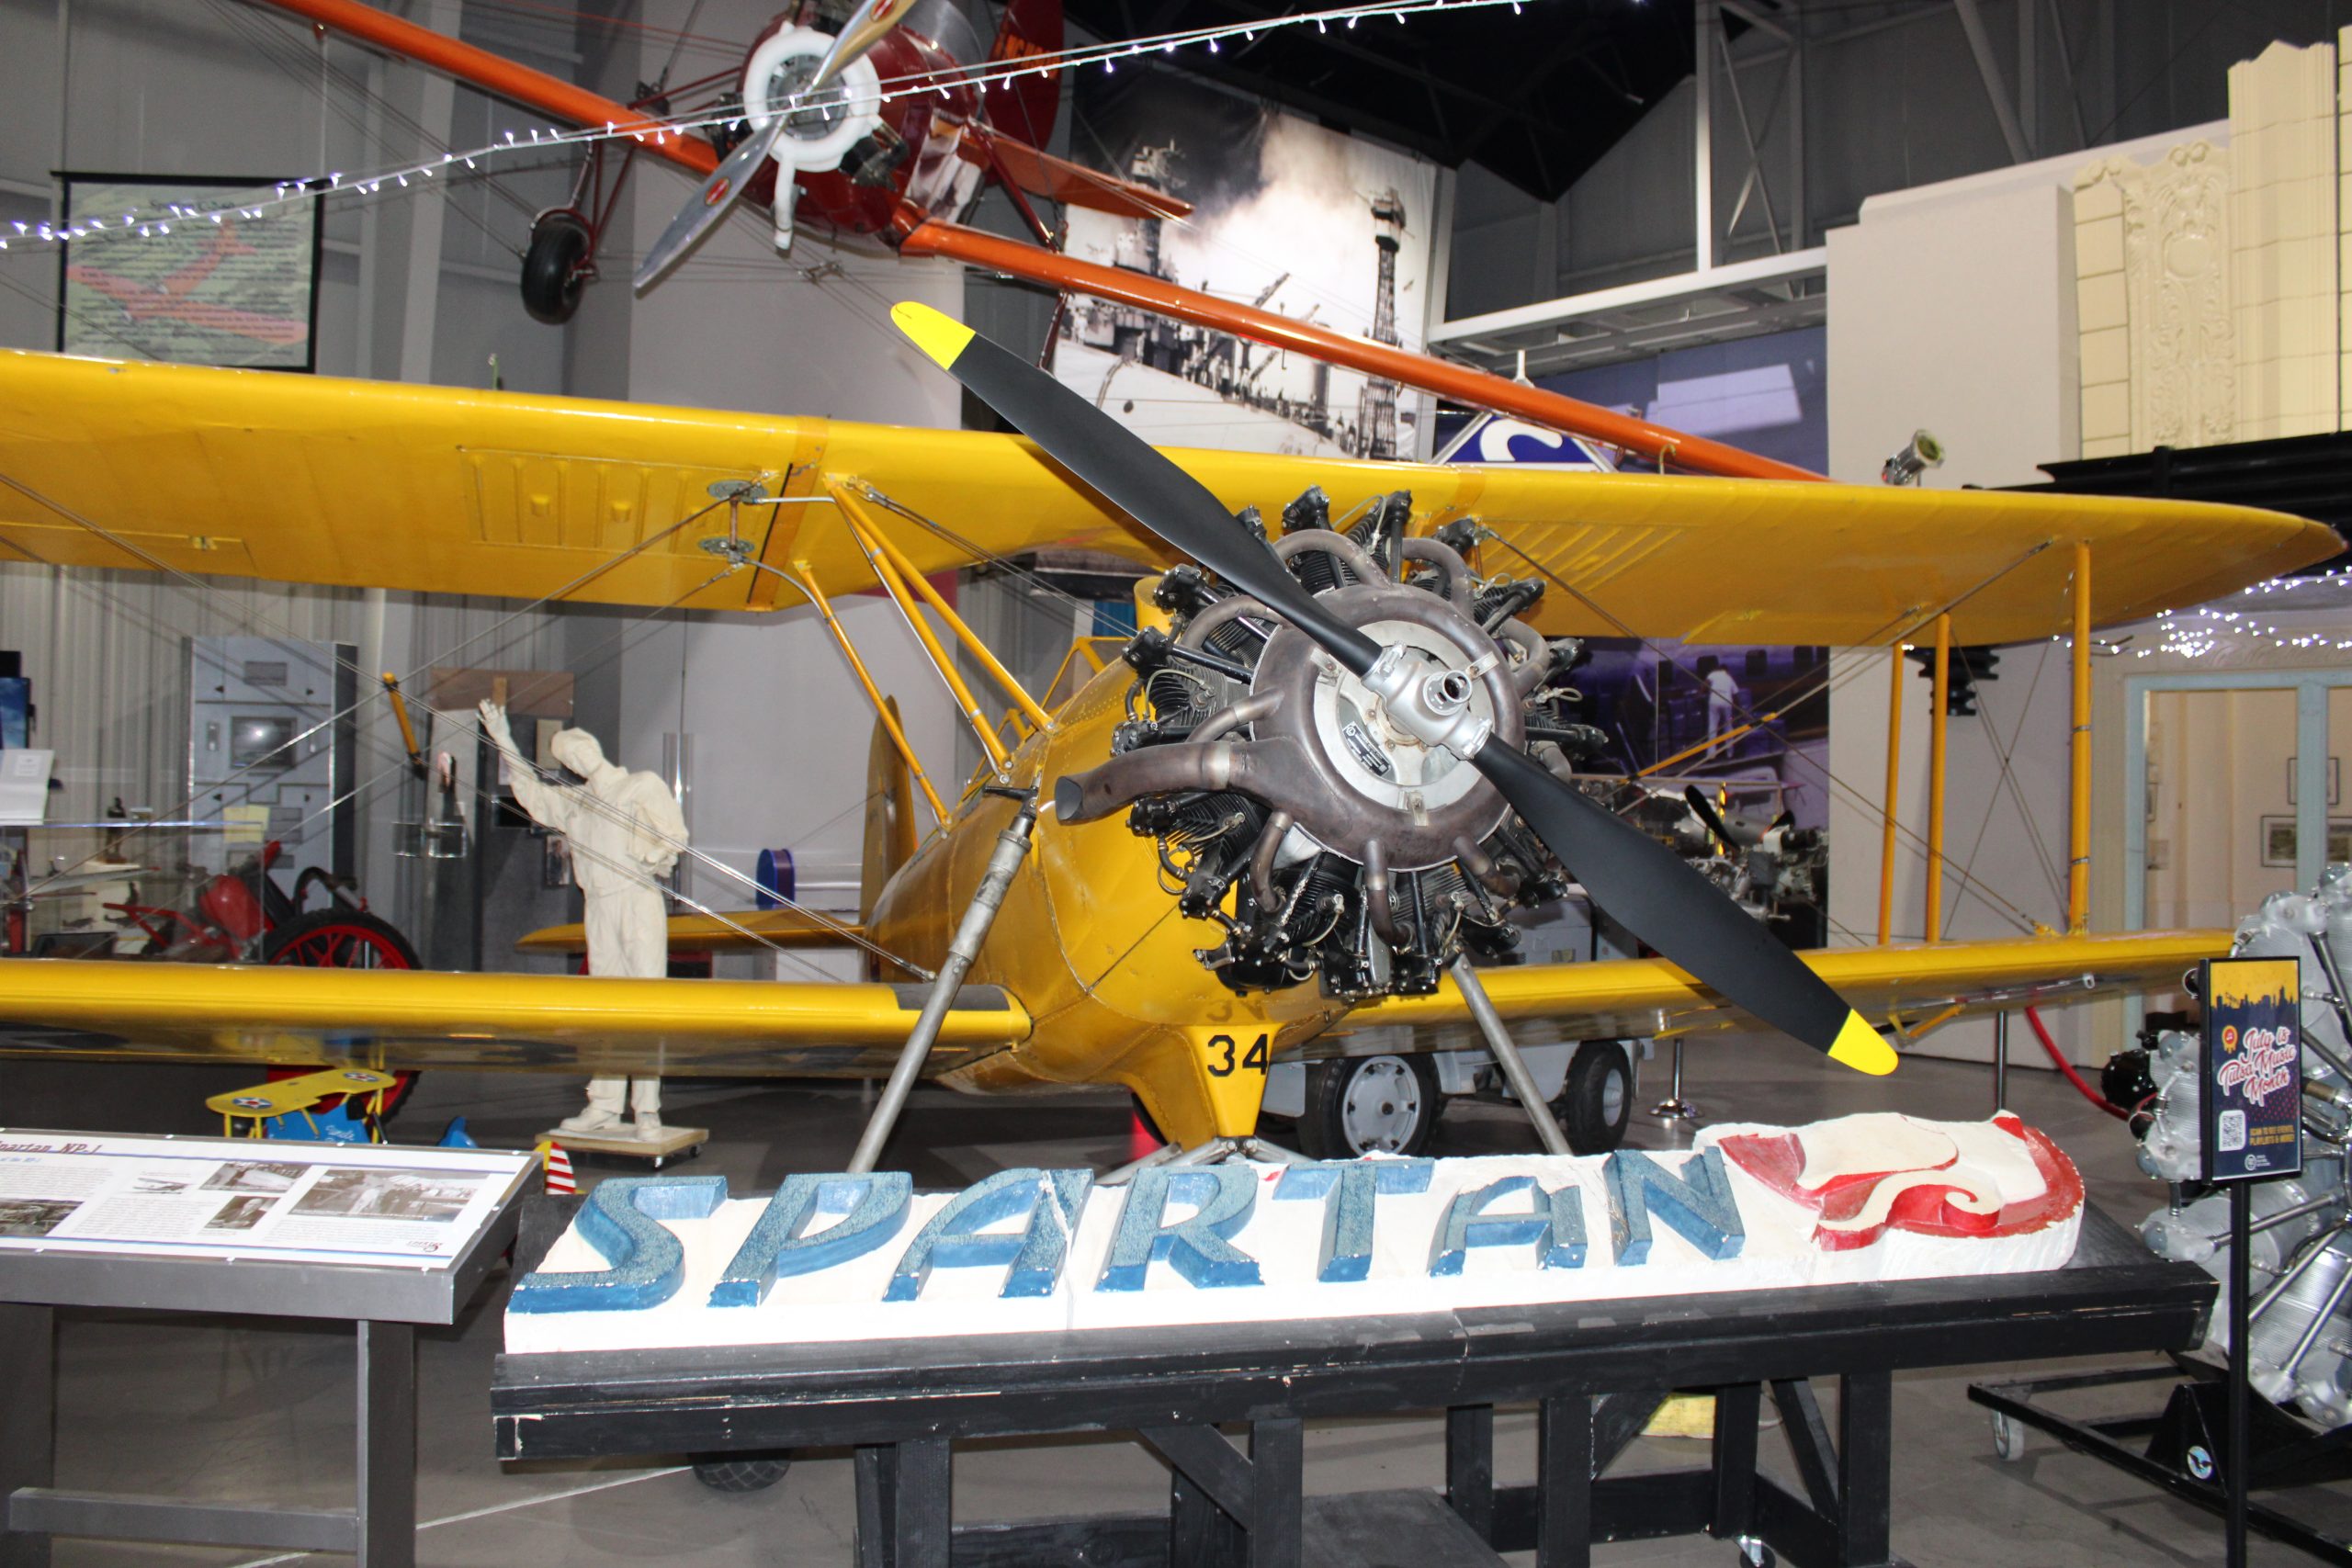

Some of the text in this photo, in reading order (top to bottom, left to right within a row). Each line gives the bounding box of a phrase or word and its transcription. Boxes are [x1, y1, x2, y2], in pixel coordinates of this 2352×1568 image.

[1207, 1034, 1268, 1077] 34
[2240, 1026, 2290, 1066] July is
[2217, 1044, 2297, 1096] Tulsa Music
[2243, 1066, 2290, 1107] Month
[0, 1140, 51, 1153] partan
[504, 1145, 1746, 1314] SPARTAN
